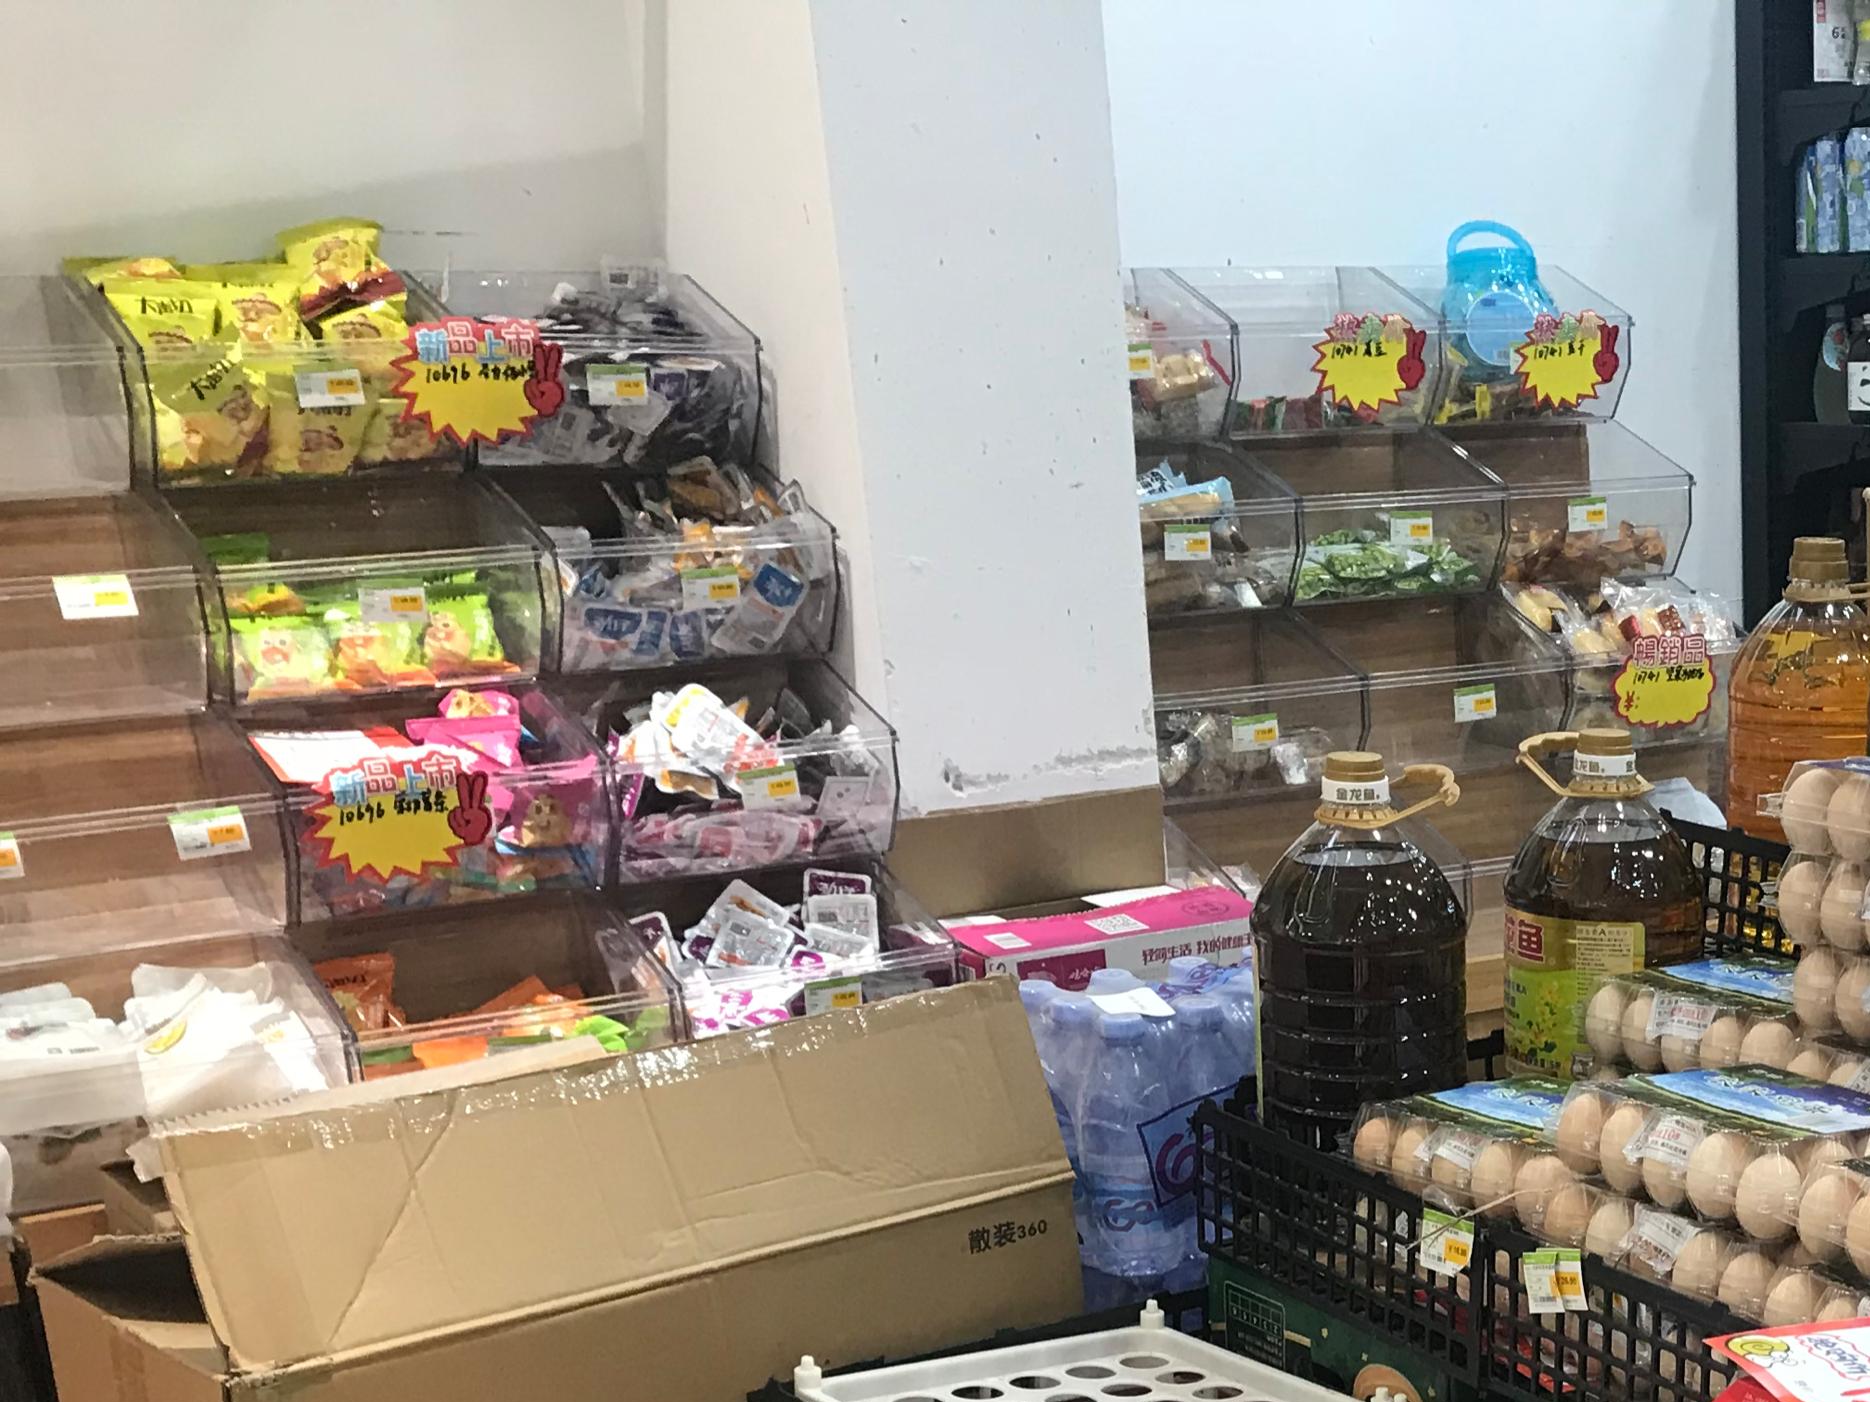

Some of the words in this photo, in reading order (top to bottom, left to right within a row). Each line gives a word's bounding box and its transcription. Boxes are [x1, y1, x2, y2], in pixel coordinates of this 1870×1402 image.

[1633, 637, 1705, 668] 暢銷品
[1336, 788, 1375, 800] 金龙鱼
[968, 1219, 1047, 1255] 散装360
